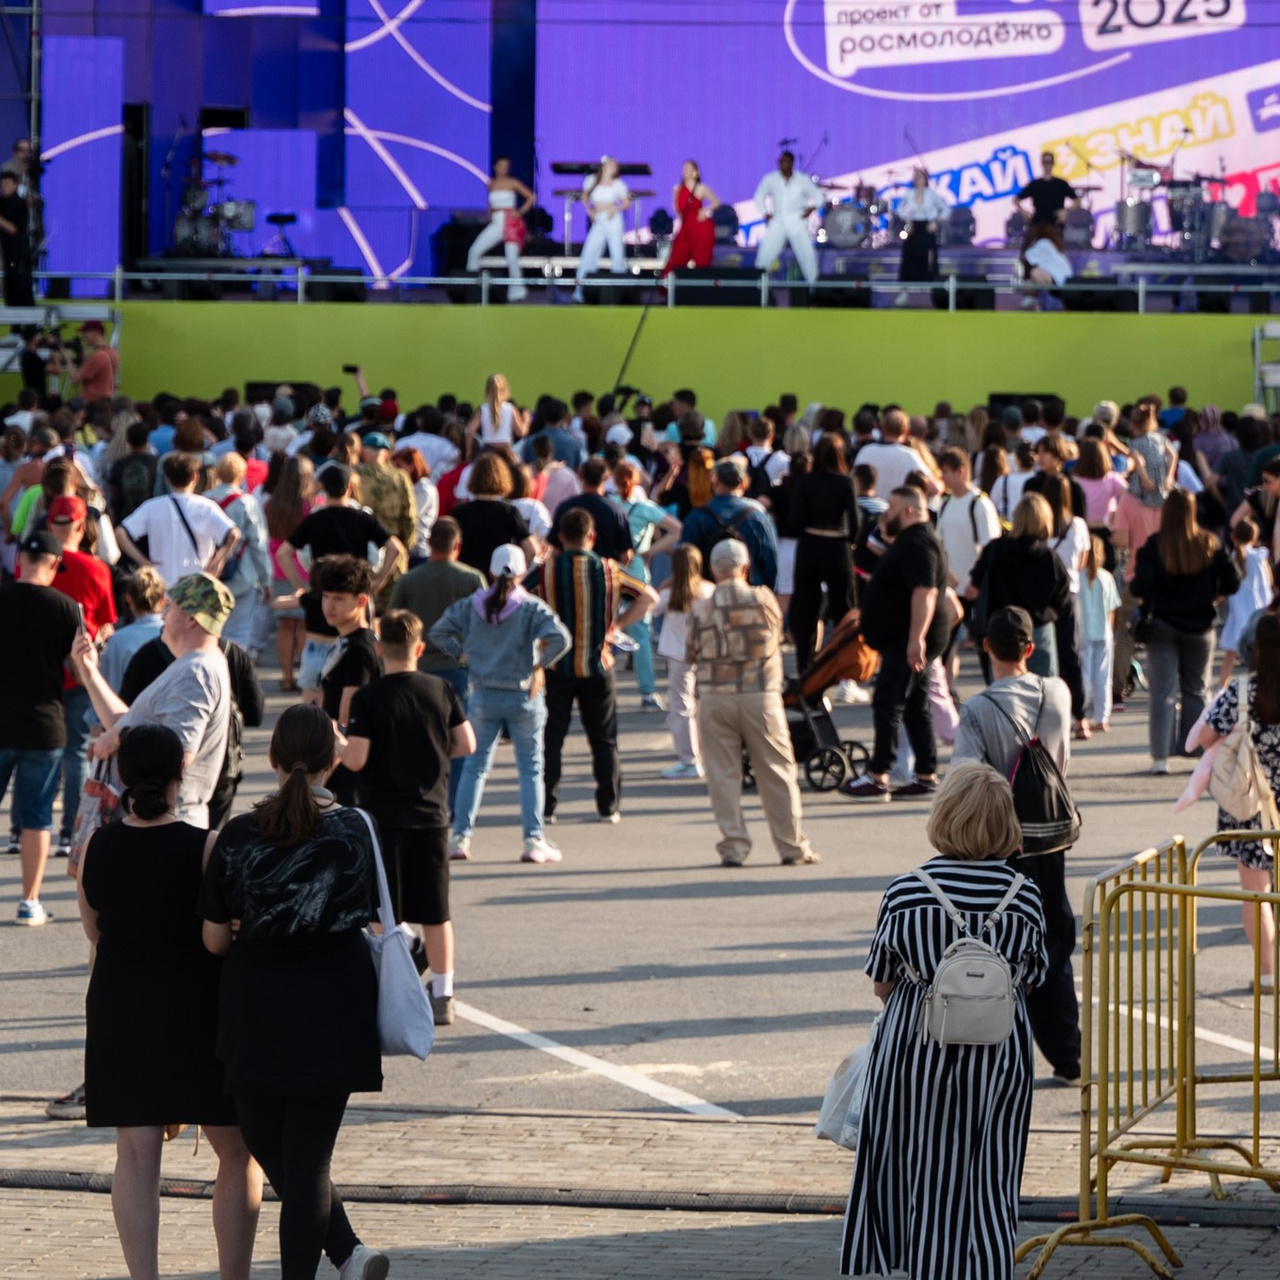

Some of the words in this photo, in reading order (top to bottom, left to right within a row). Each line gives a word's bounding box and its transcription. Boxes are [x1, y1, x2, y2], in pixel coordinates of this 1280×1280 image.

[837, 6, 910, 26] проект
[918, 3, 944, 18] от
[1085, 97, 1231, 164] ЗНАЙ
